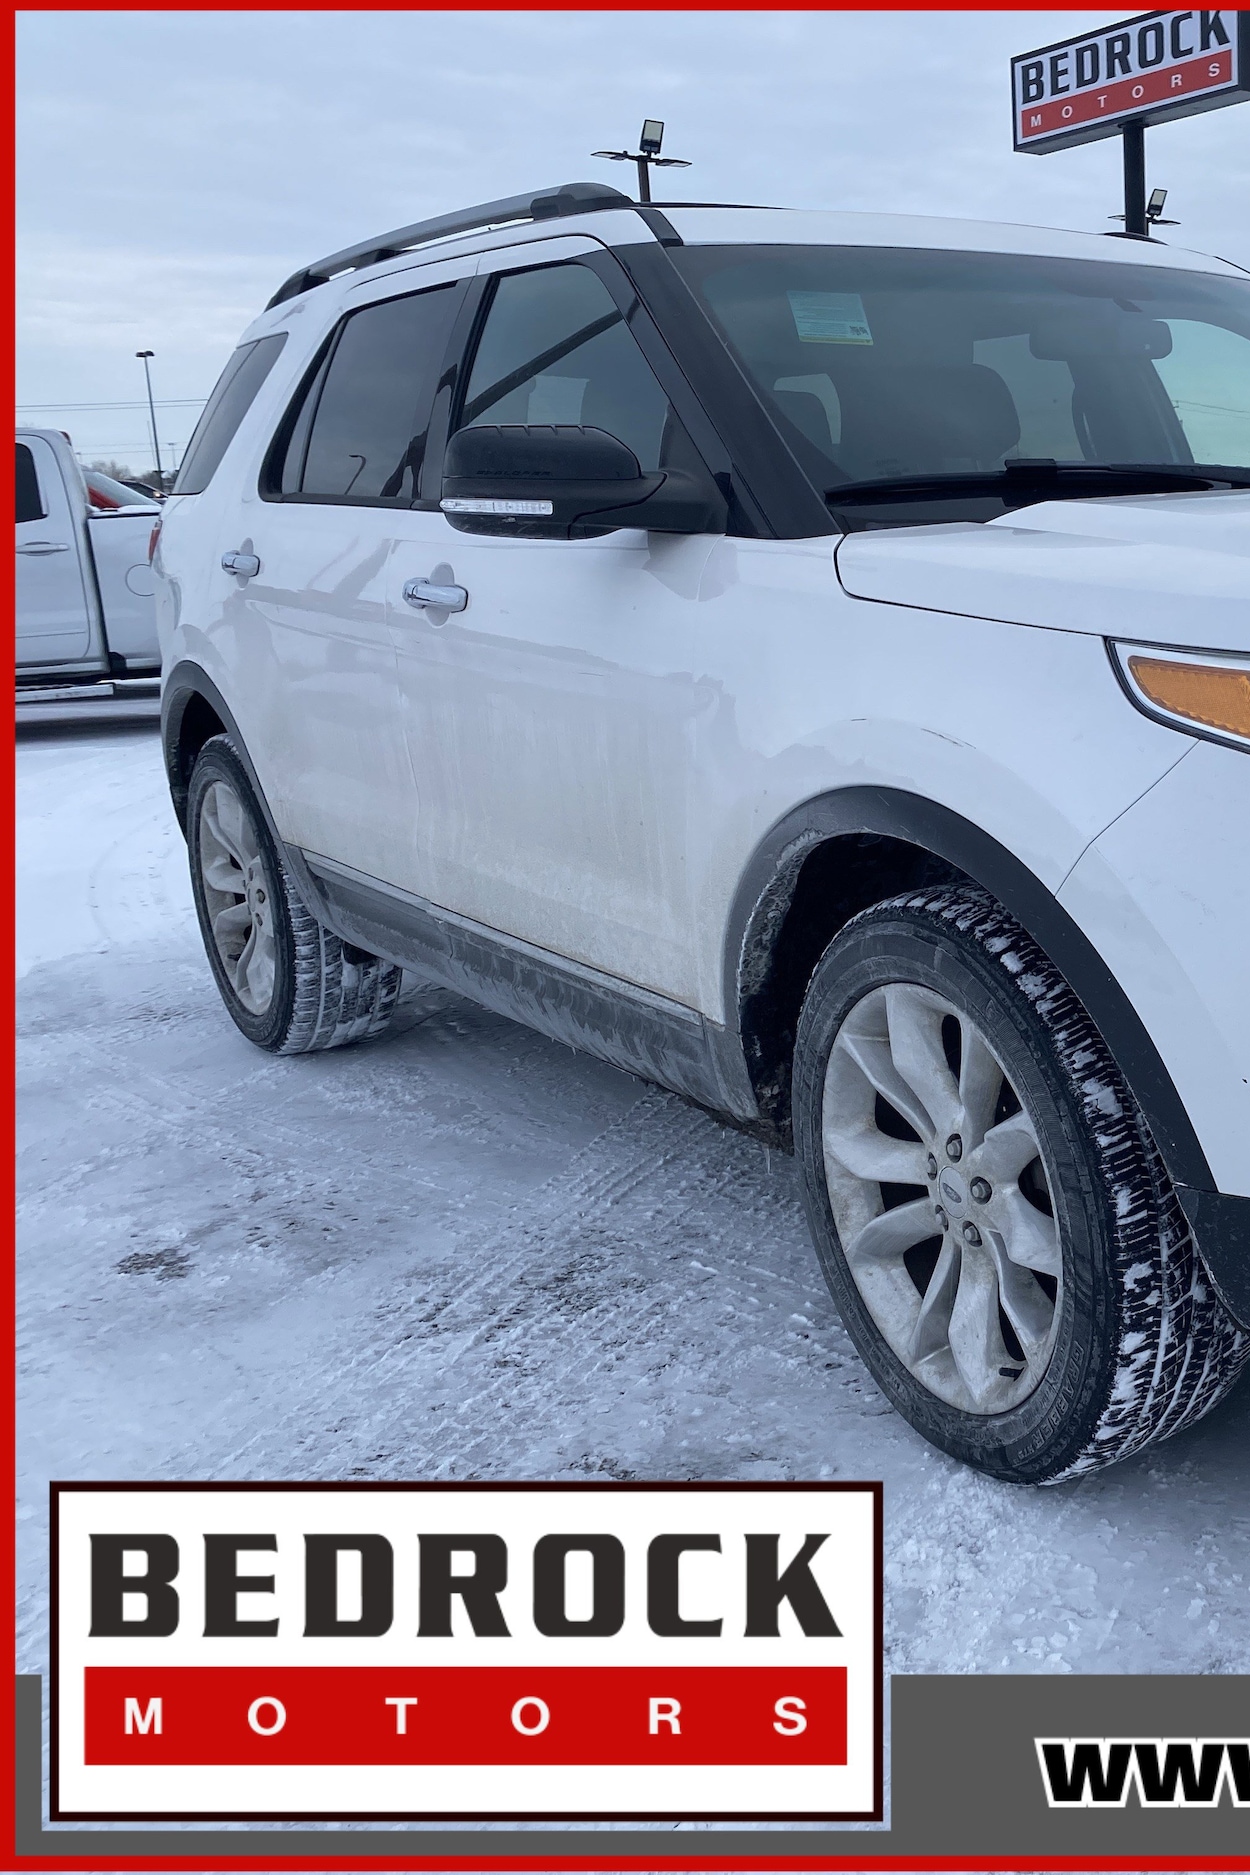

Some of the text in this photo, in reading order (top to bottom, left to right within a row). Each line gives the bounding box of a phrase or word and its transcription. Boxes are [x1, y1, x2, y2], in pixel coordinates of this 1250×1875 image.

[1022, 10, 1231, 105] BEDROCK
[1030, 62, 1221, 128] MOTORS
[1033, 1340, 1085, 1449] GRABBER
